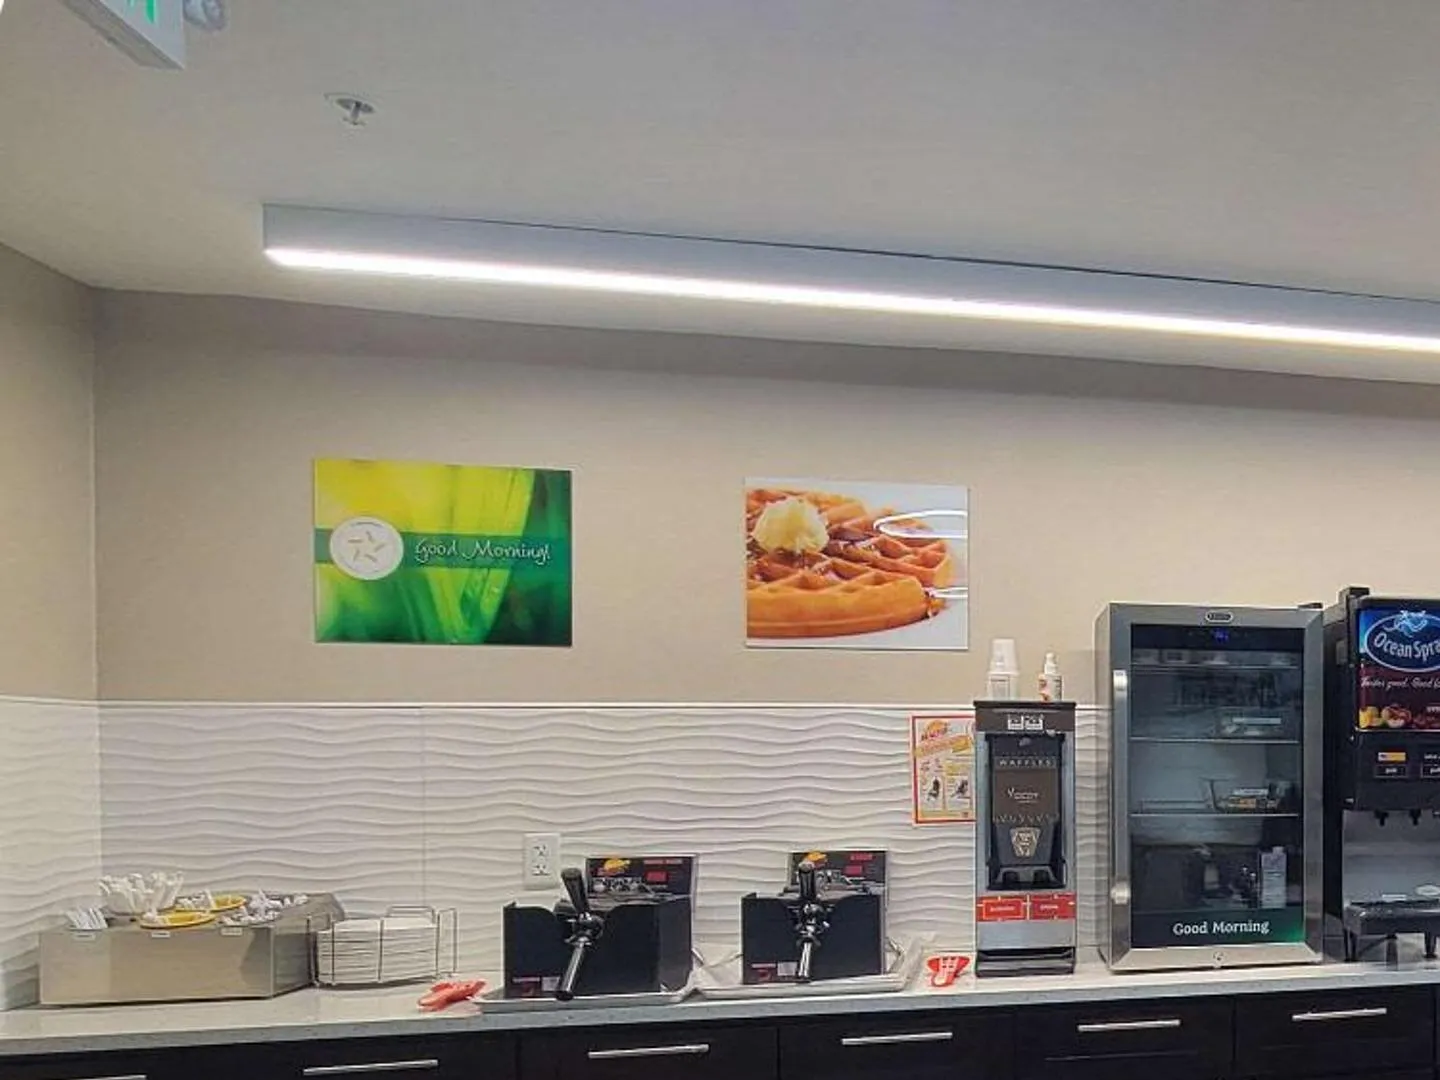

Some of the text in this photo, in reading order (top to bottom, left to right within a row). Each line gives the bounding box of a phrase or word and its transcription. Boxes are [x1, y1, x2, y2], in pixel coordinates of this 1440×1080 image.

[415, 538, 551, 565] Good Morning!
[1373, 632, 1412, 658] Ocean
[1172, 919, 1270, 936] Good Morning
